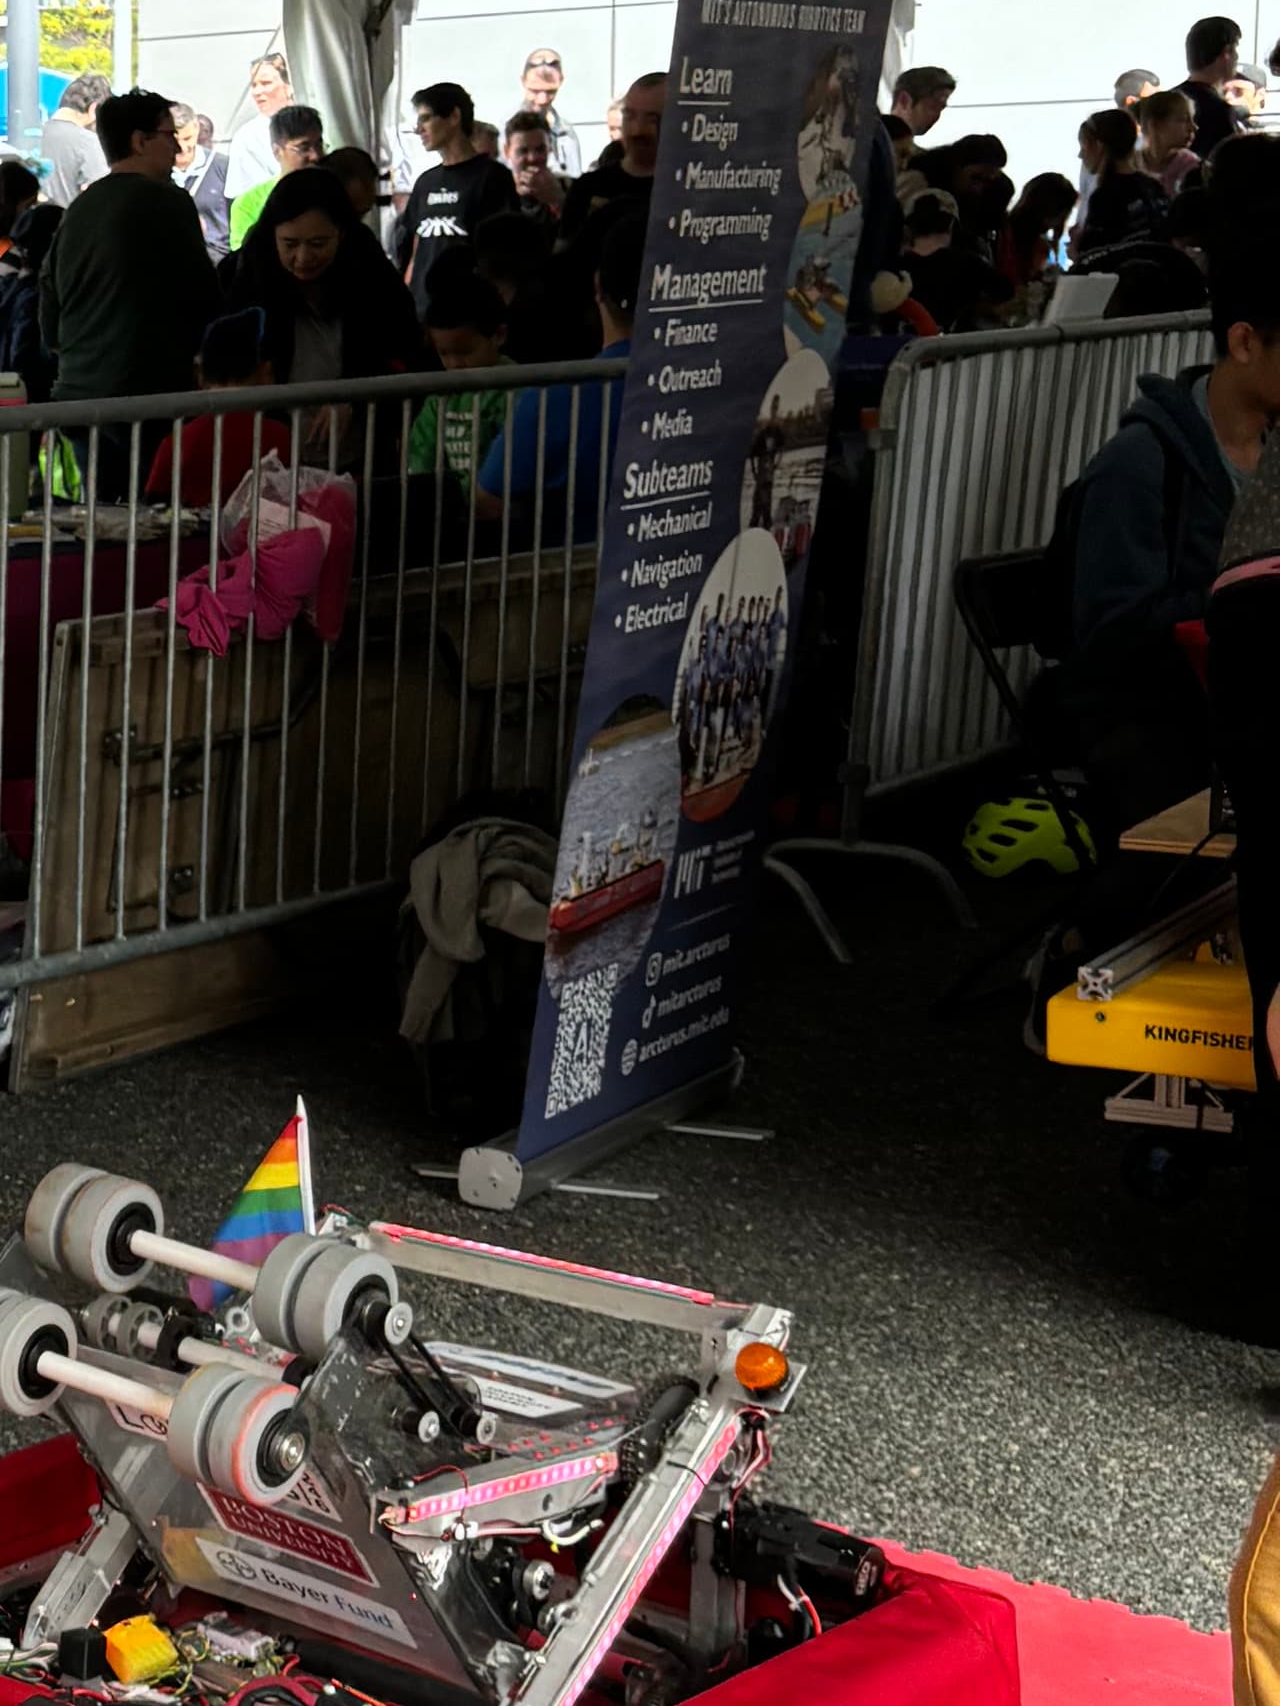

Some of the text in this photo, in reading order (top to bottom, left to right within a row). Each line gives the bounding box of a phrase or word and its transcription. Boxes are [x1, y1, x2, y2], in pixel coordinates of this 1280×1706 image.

[843, 7, 866, 34] TEAM
[679, 55, 733, 96] Learn
[691, 113, 739, 152] Design
[685, 159, 783, 196] Manufacturing
[679, 206, 773, 245] Programming
[650, 262, 768, 308] Management
[664, 318, 719, 348] Finance
[658, 358, 723, 394] Outreach
[652, 407, 693, 441] Media
[623, 458, 714, 500] Subteams
[637, 500, 713, 543] Mechanical
[630, 548, 703, 590] Navigation
[624, 591, 689, 634] Electrical
[223, 1497, 349, 1556] BOSTON
[231, 1515, 354, 1569] UNIVERSITY
[261, 1568, 395, 1631] Bayer Fund
